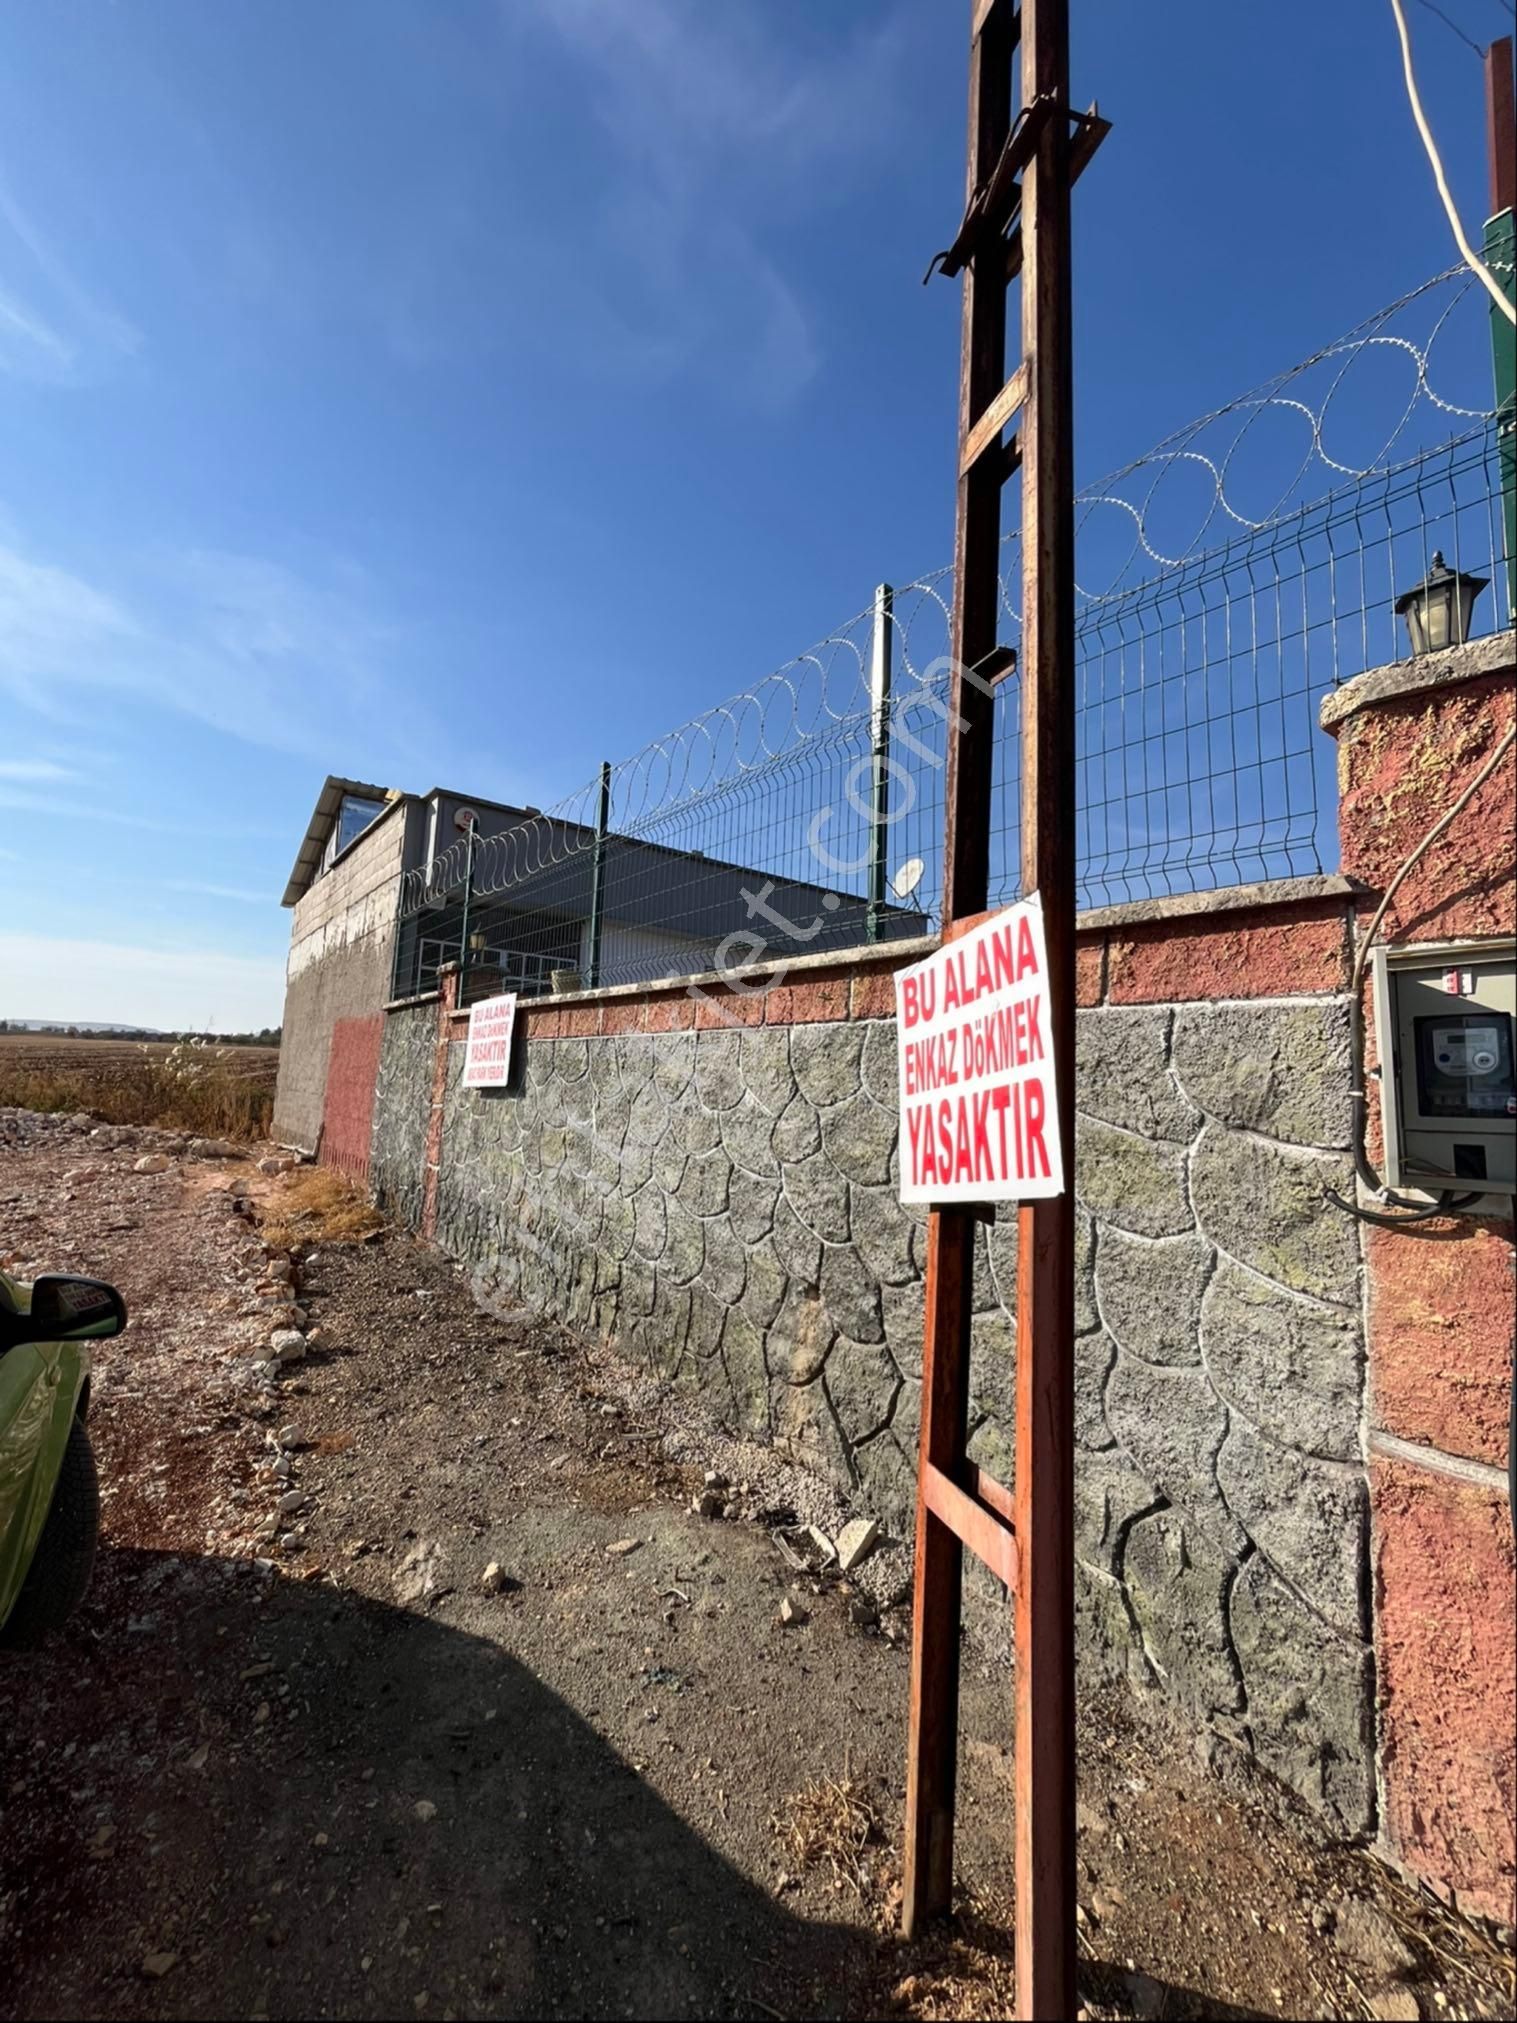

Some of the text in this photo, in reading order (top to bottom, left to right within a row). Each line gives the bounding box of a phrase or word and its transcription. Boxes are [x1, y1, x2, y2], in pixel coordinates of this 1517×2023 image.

[484, 1003, 511, 1021] ALANA
[903, 916, 1039, 1028] BU ALANA
[905, 1029, 958, 1096] ENKAZ
[907, 1077, 1052, 1187] YASAKTIR
